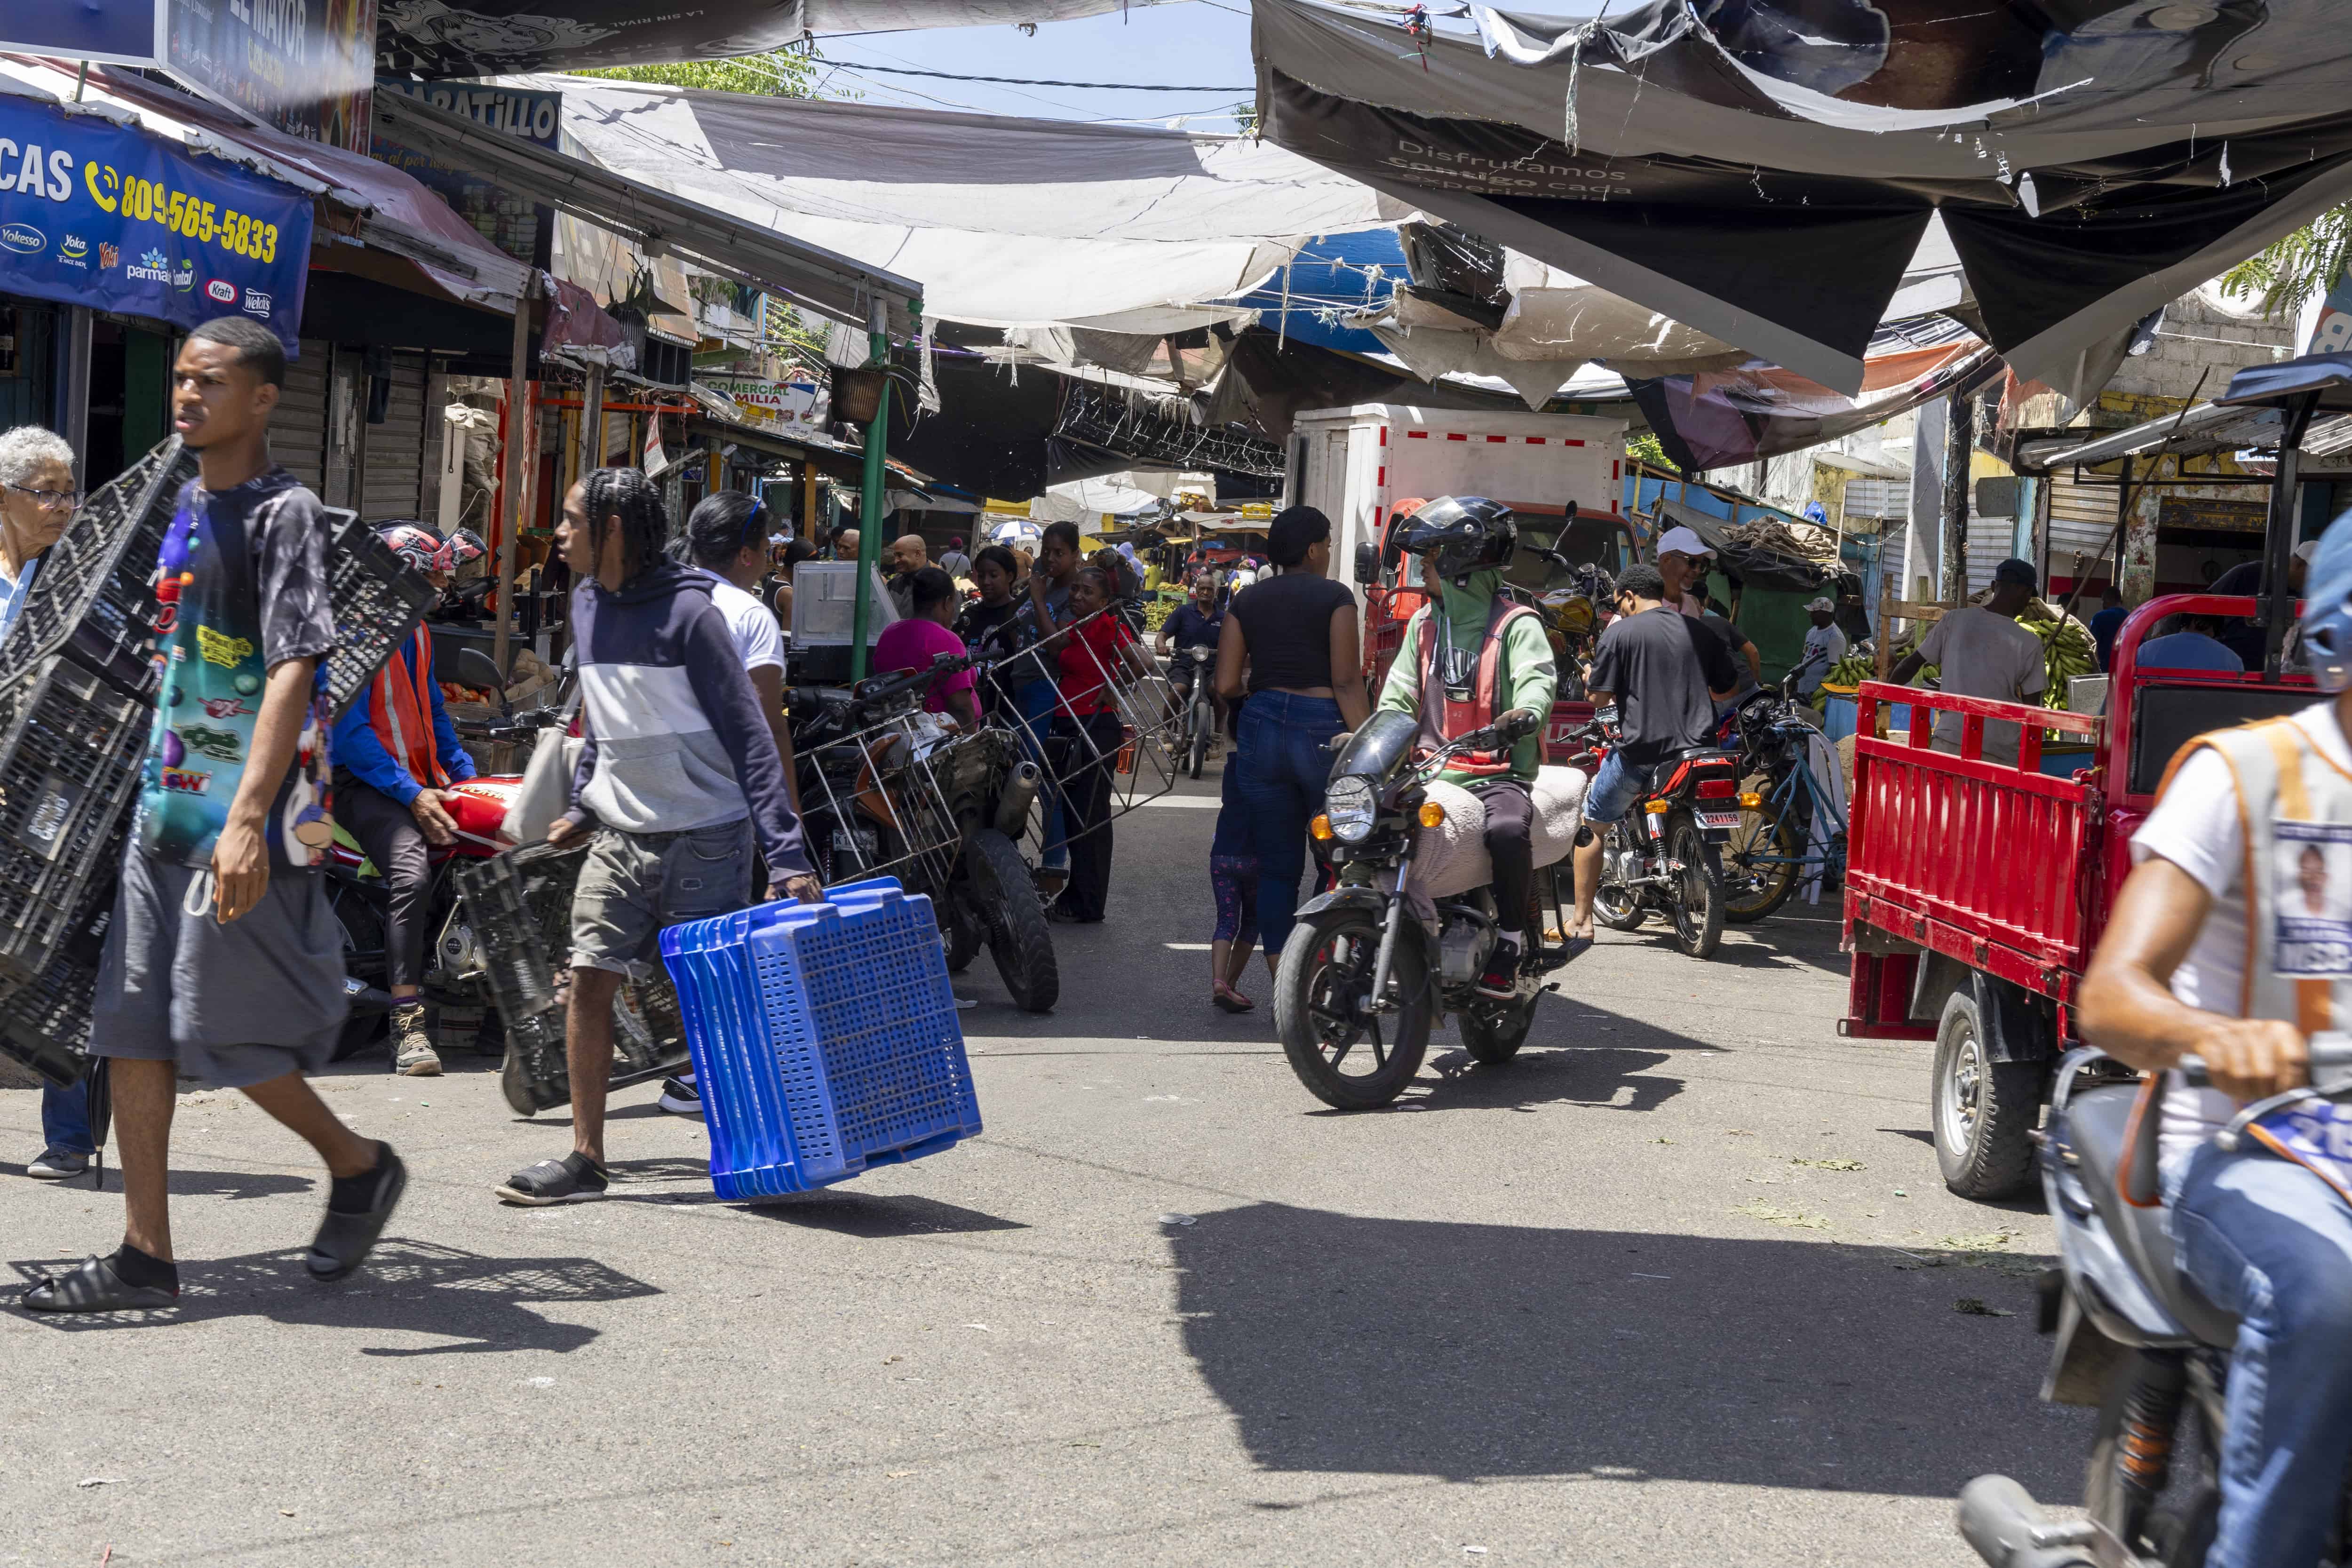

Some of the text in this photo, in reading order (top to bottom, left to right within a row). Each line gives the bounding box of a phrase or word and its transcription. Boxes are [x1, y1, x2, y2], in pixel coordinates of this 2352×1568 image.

[610, 17, 651, 27] RIVAL
[1399, 140, 1626, 181] Disfrutamos
[121, 175, 278, 263] 809-565-5833
[2, 229, 40, 247] Yokesso
[64, 234, 86, 249] Yoka
[99, 242, 119, 270] Yoki
[212, 284, 231, 299] Kraft
[245, 294, 271, 310] Welch's
[707, 381, 789, 396] COMERCIAL
[734, 393, 781, 405] MILIA
[1706, 814, 1738, 823] 2241159
